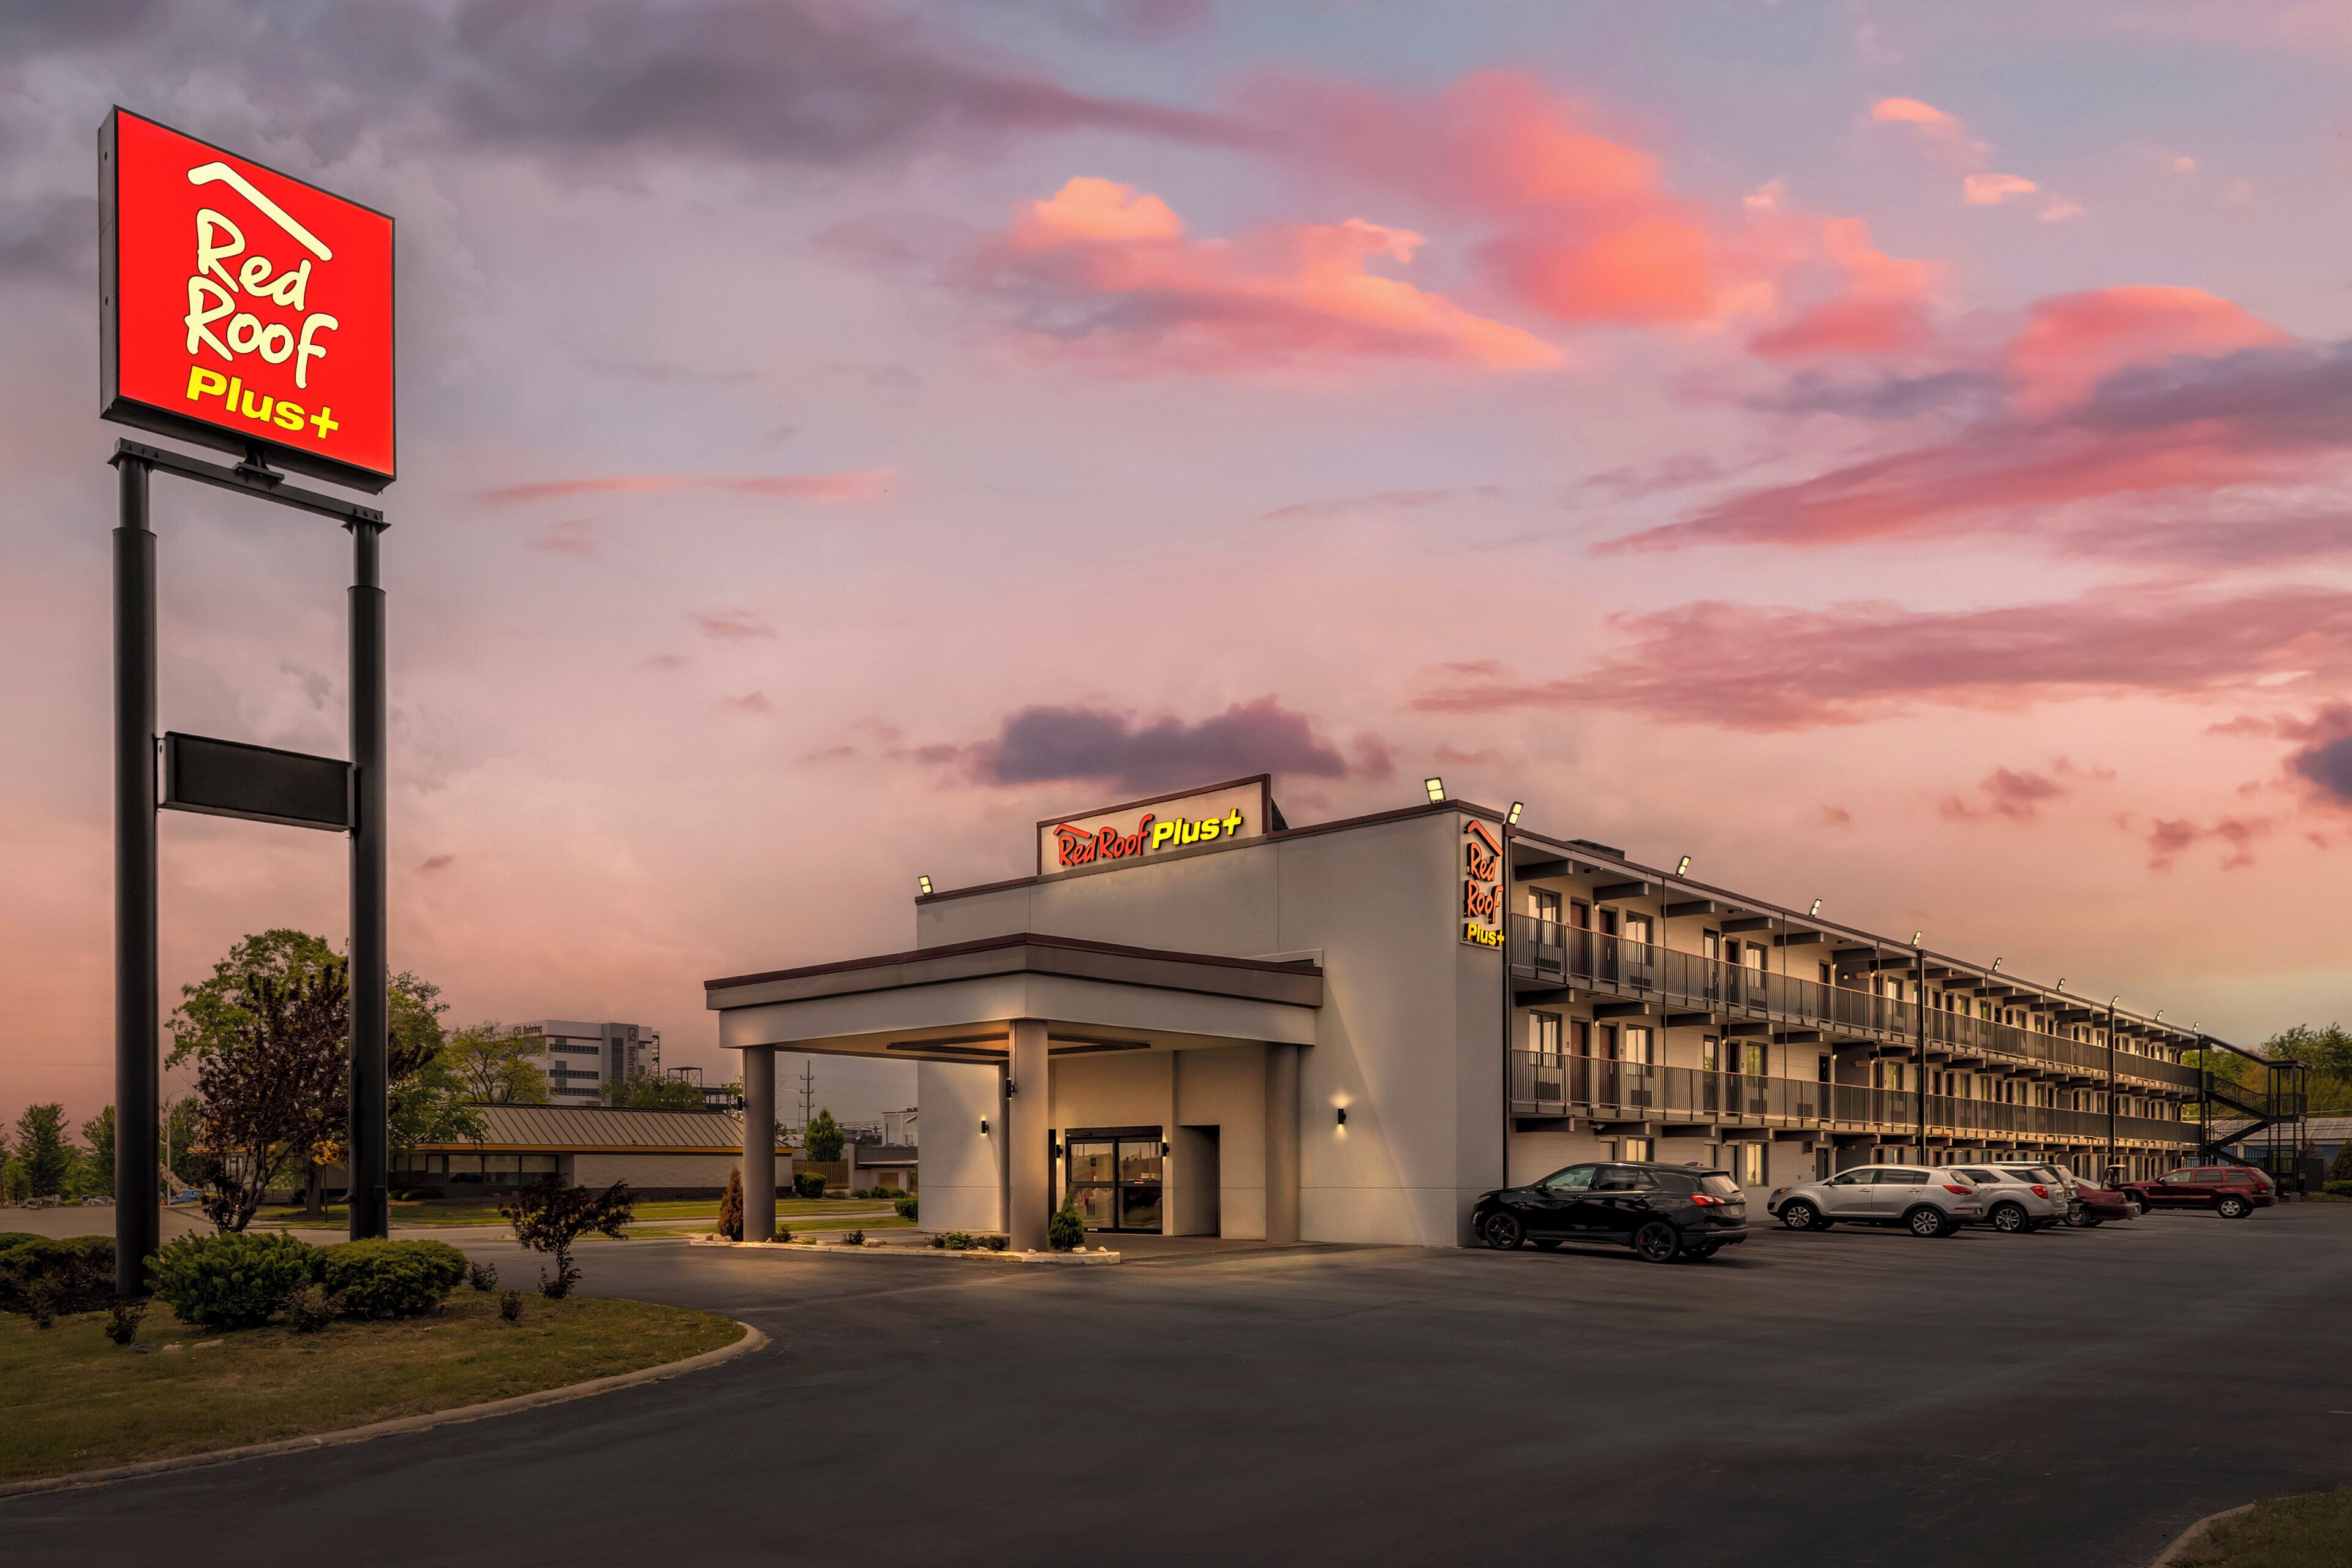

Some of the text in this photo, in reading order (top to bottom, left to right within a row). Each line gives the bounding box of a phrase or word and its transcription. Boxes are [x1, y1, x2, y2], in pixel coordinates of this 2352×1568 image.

[197, 208, 312, 312] Red
[184, 276, 339, 389] Roof
[186, 365, 339, 439] Plus+
[1058, 808, 1243, 866] Red Roof Plus+
[1469, 842, 1497, 882] Red
[1467, 879, 1504, 924] Roof
[1467, 923, 1505, 946] Plus+
[523, 1024, 543, 1035] Behring
[628, 1027, 636, 1044] CSL
